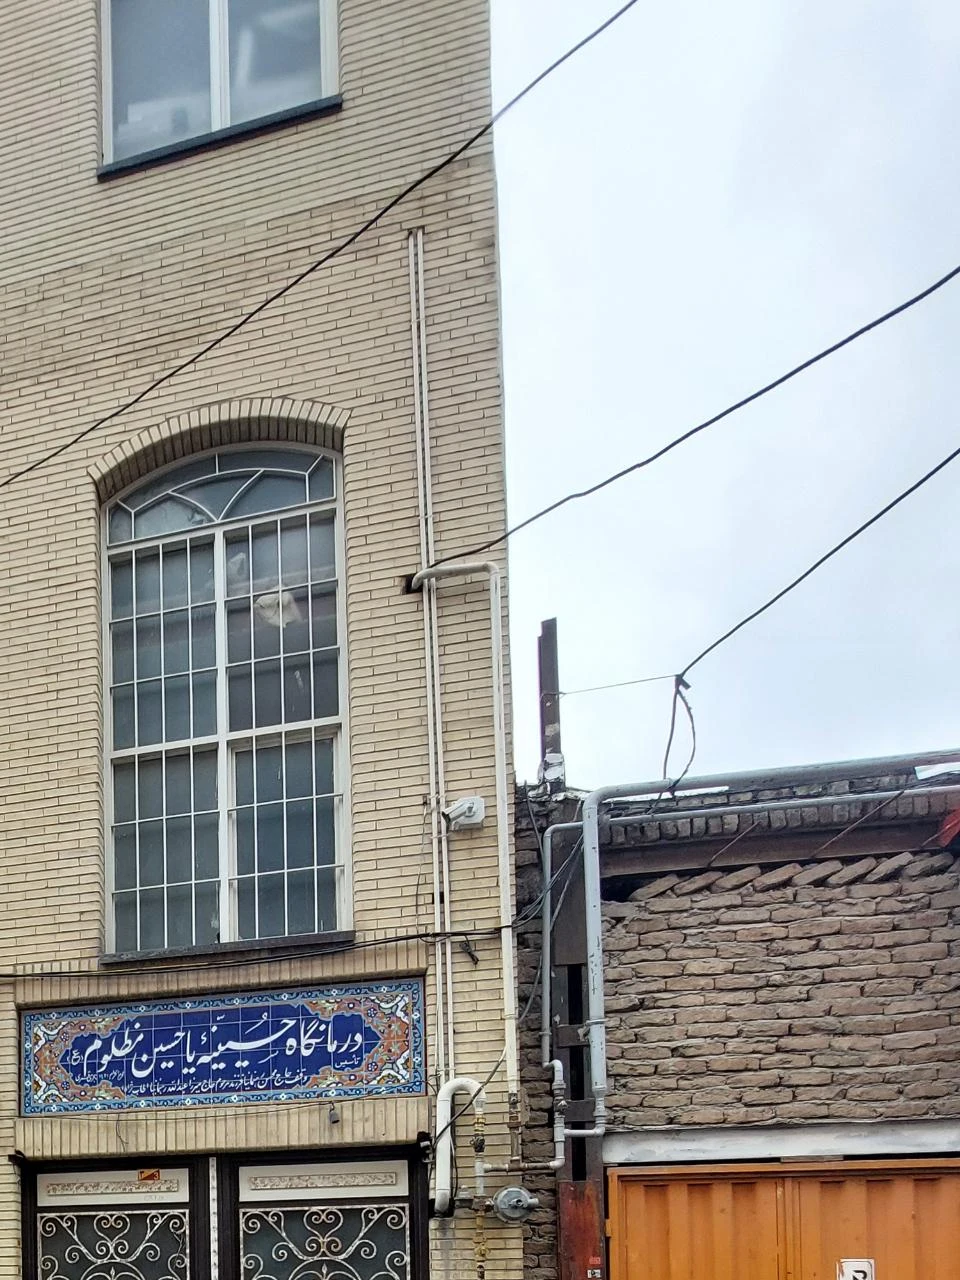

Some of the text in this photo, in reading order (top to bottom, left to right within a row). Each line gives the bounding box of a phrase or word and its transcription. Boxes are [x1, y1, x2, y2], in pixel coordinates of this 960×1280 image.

[83, 1022, 144, 1076] مظلوم
[285, 1019, 363, 1057] درمانگاه
[131, 1030, 186, 1078] حسین
[201, 1078, 215, 1092] حاج
[285, 1068, 308, 1084] وقف
[153, 1171, 159, 1180] 3
